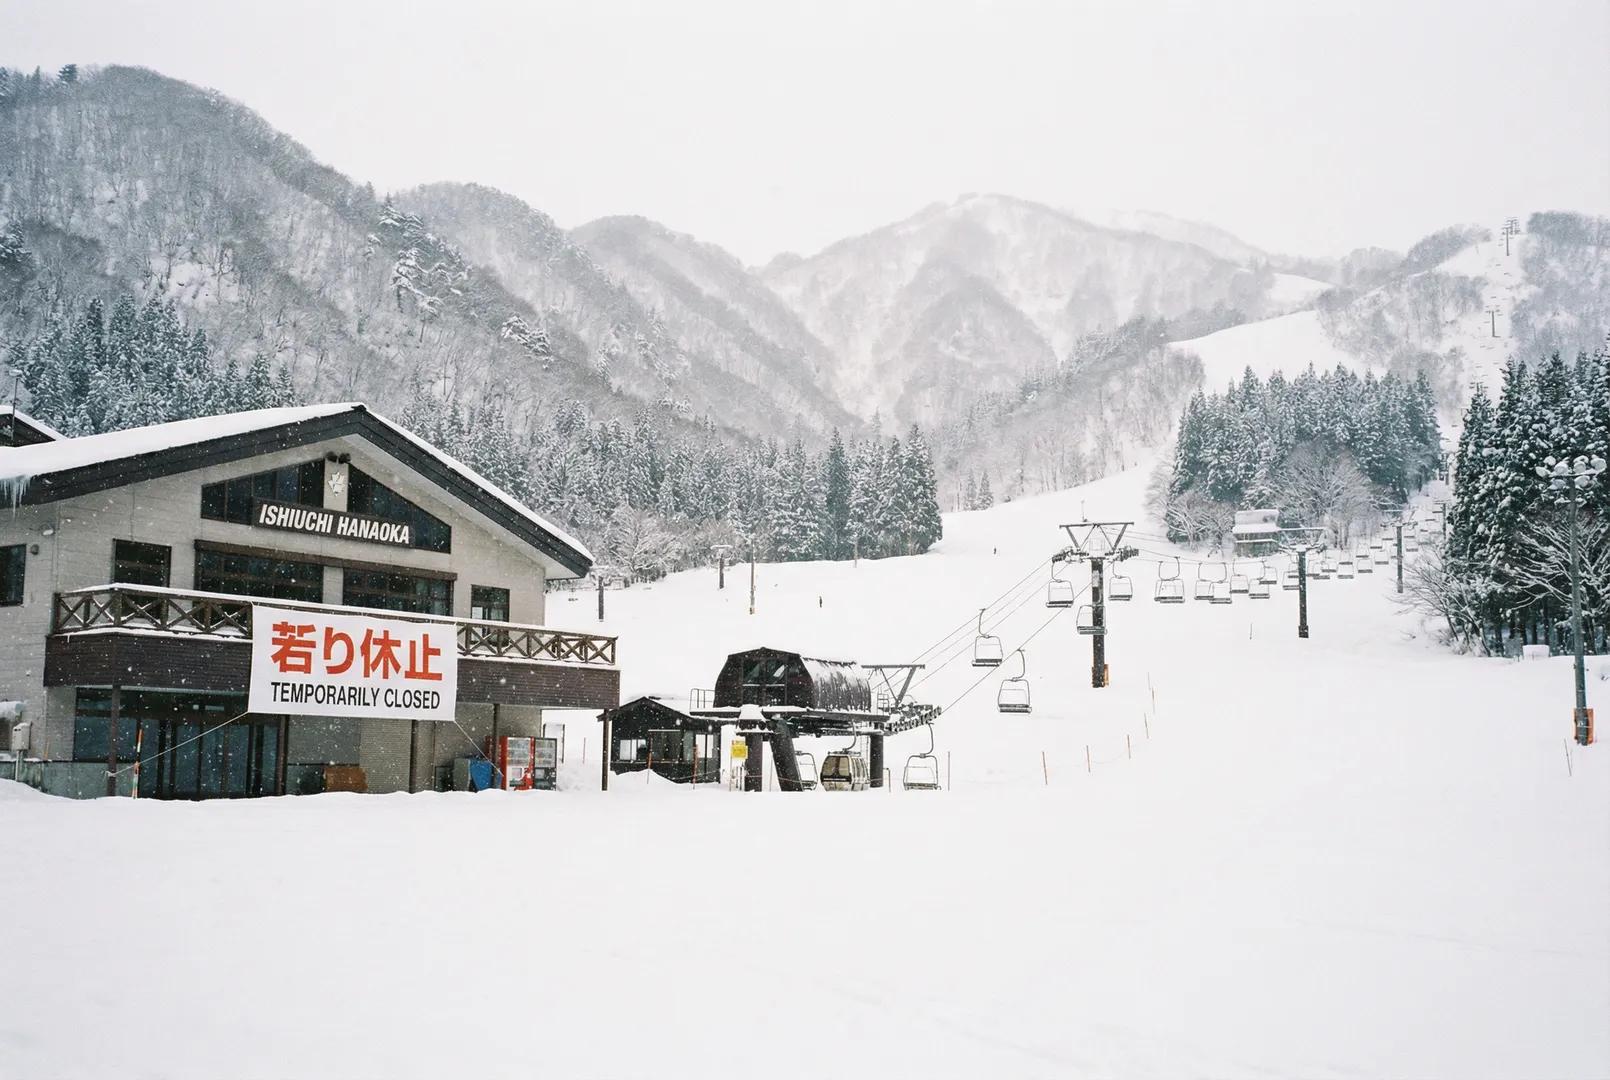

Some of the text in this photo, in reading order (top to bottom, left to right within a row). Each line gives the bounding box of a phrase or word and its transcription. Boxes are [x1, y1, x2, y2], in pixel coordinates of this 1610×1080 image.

[259, 504, 410, 544] ISHIUCHI HANAOKA
[271, 681, 440, 710] TEMPORARILY CLOSED
